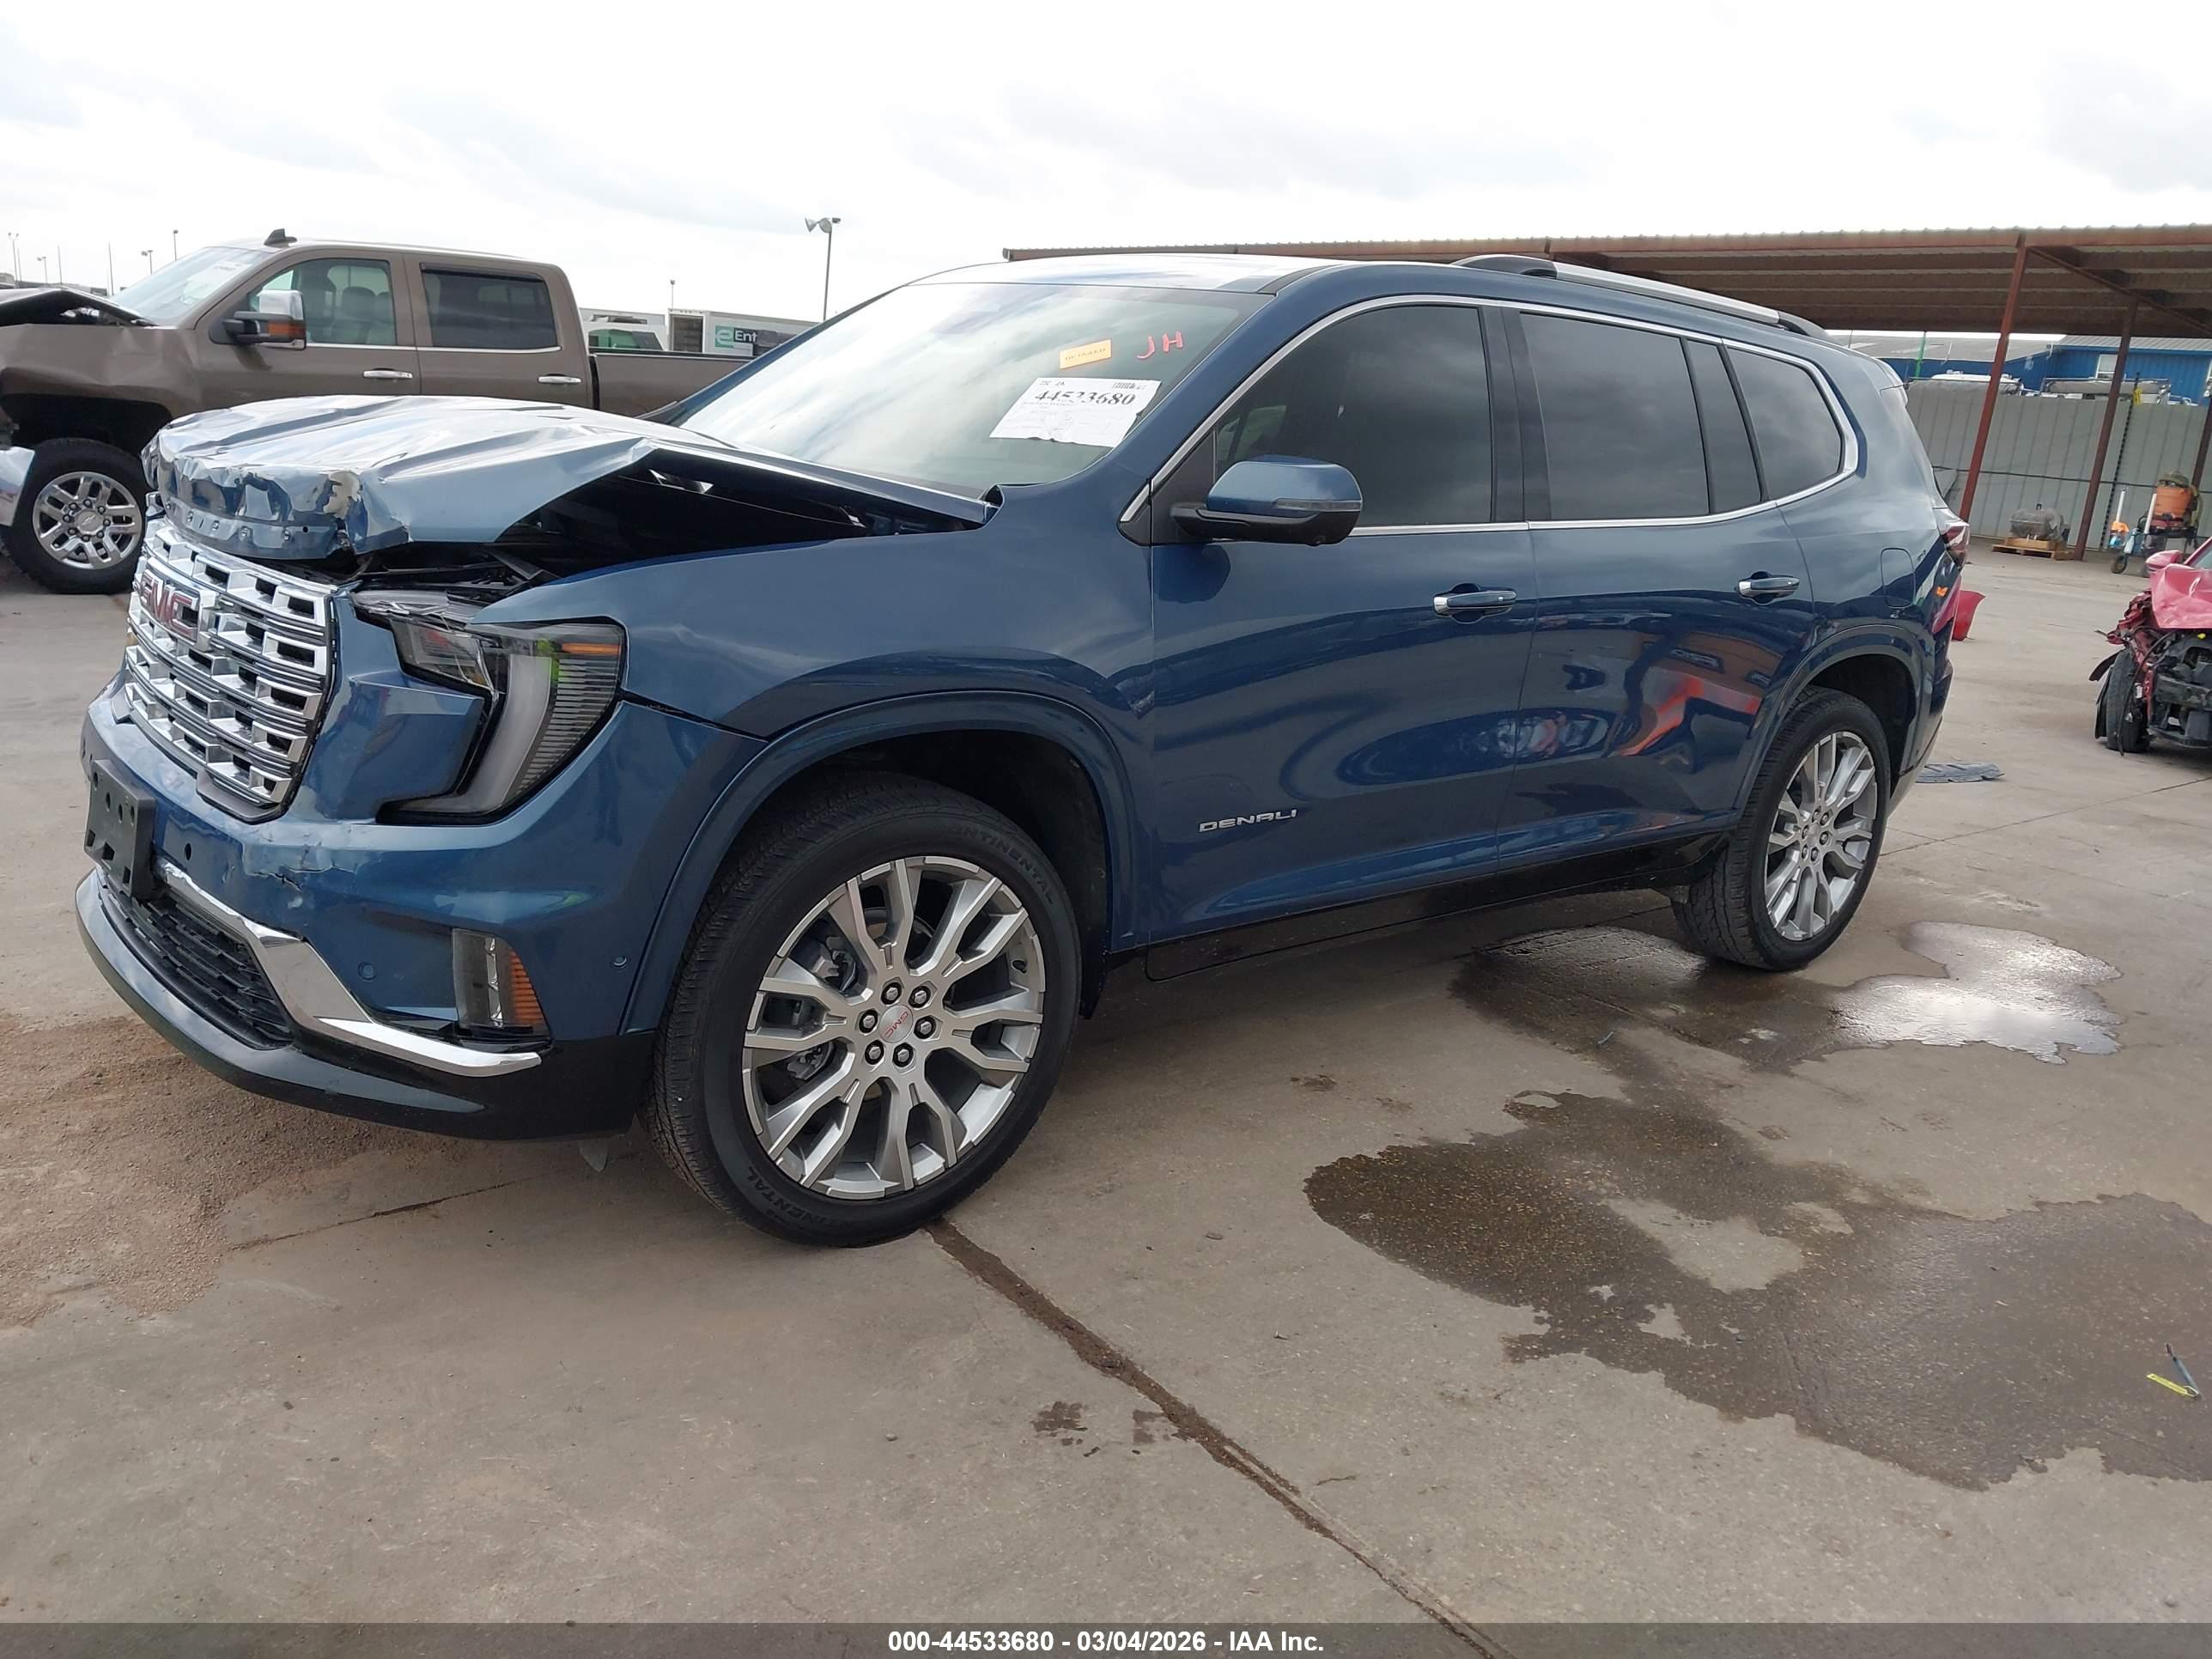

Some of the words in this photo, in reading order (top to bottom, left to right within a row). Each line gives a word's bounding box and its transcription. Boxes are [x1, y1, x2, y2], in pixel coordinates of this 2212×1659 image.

[141, 568, 198, 642] GMC
[1199, 809, 1297, 833] DENALI
[884, 1011, 908, 1038] GMC
